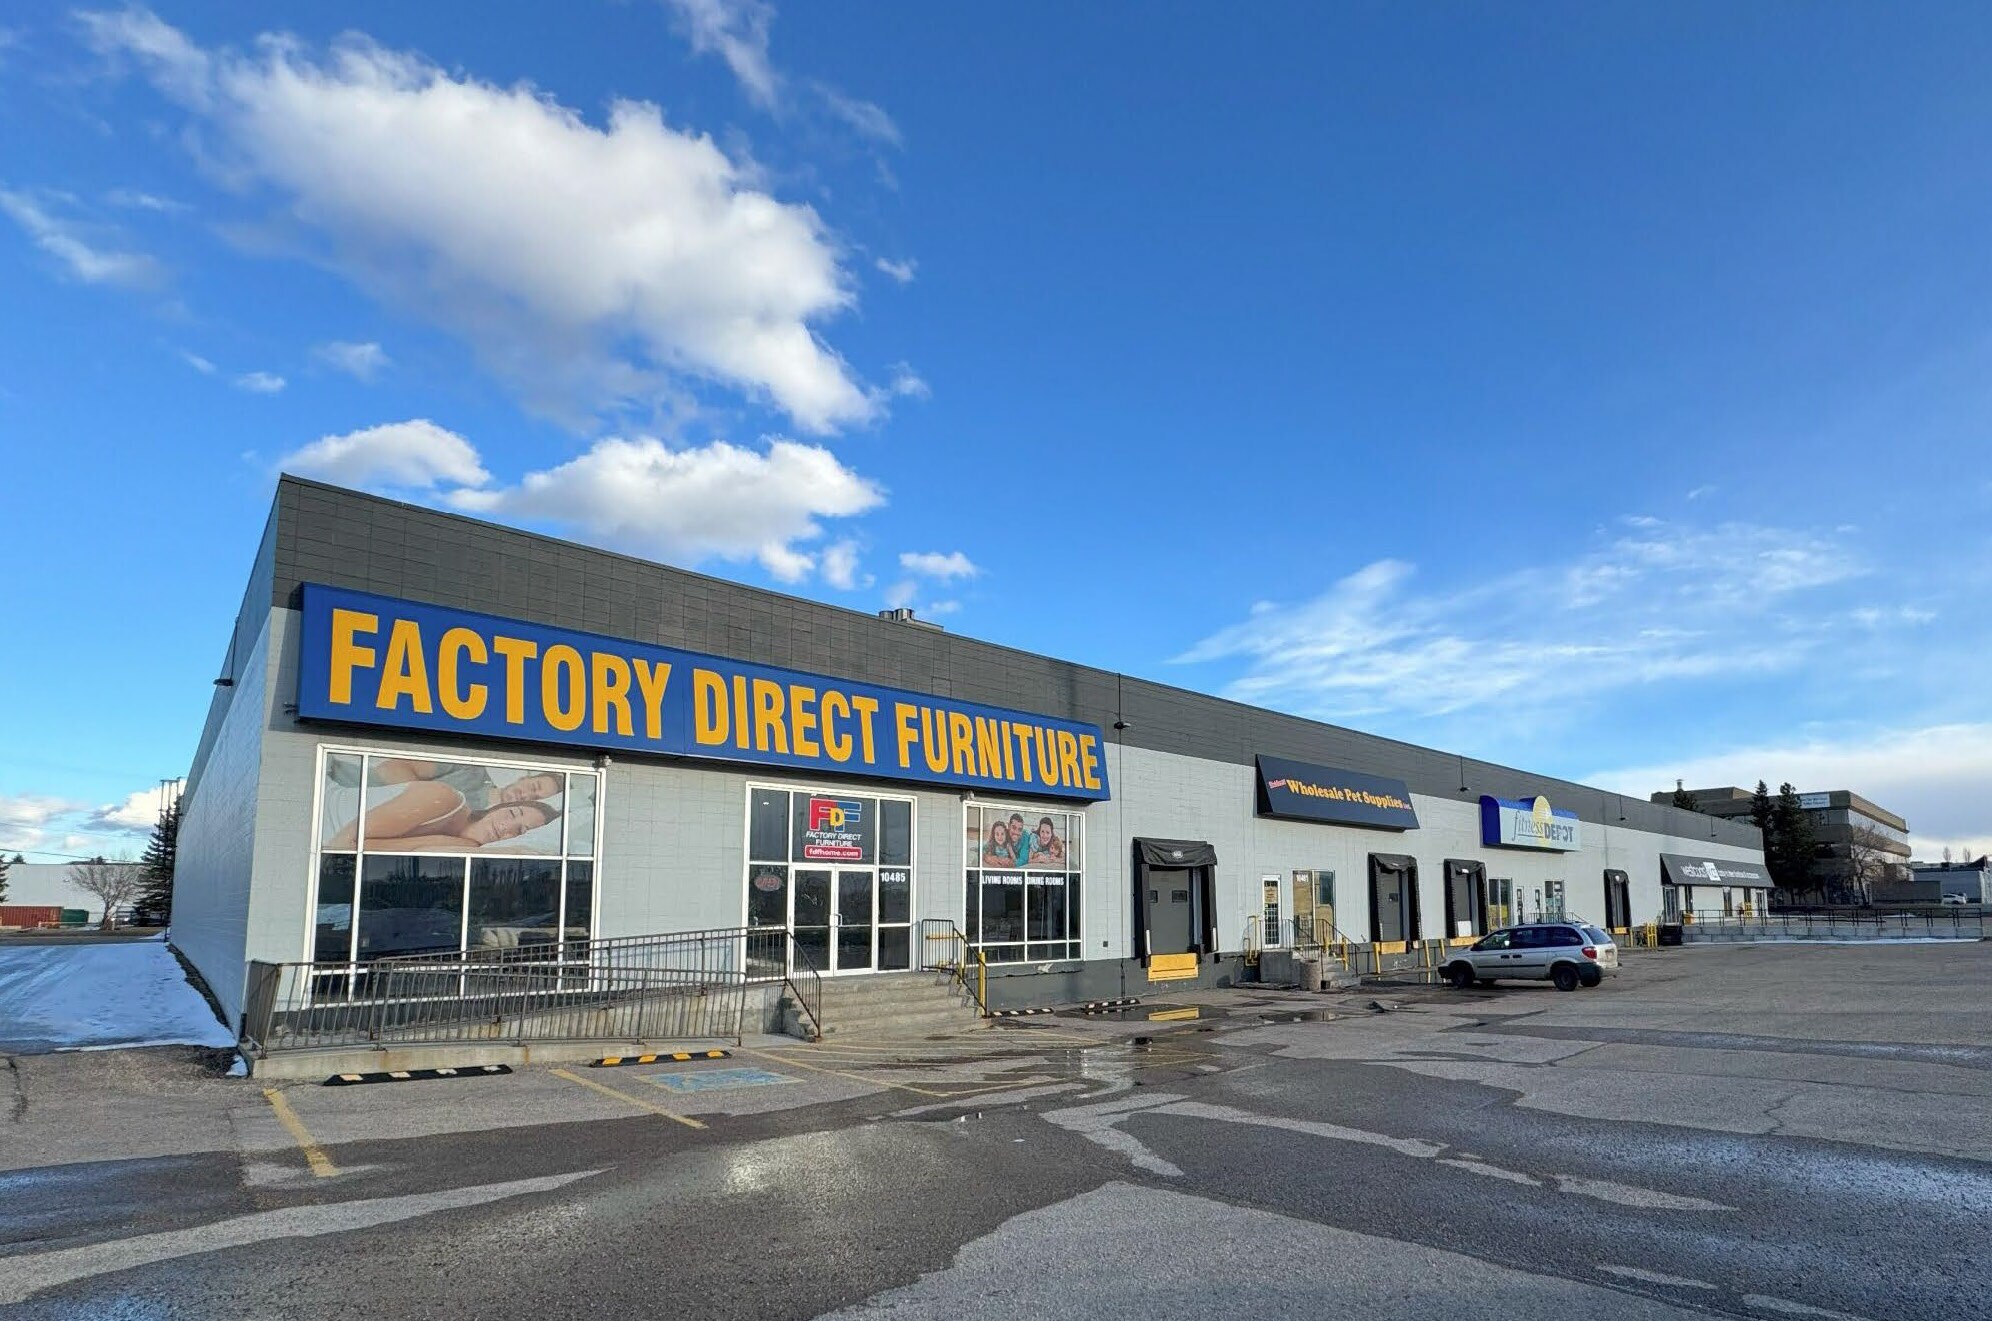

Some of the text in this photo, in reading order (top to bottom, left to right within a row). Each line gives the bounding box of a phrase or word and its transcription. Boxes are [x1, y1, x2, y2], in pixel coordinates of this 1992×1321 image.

[329, 609, 1101, 789] FACTORY DIRECT FURNITURE
[1286, 779, 1344, 800] Wholesale
[1344, 788, 1363, 803] Pet
[1363, 791, 1403, 809] Supplies
[1511, 810, 1574, 843] fitness DEPOT
[805, 831, 862, 840] FACTORY DIRECT
[815, 839, 853, 847] FURNITURE
[809, 848, 859, 857] fdfhome.com
[880, 871, 906, 883] 10485
[981, 874, 1023, 885] LIVING ROOMS
[1045, 876, 1065, 886] ROOMS
